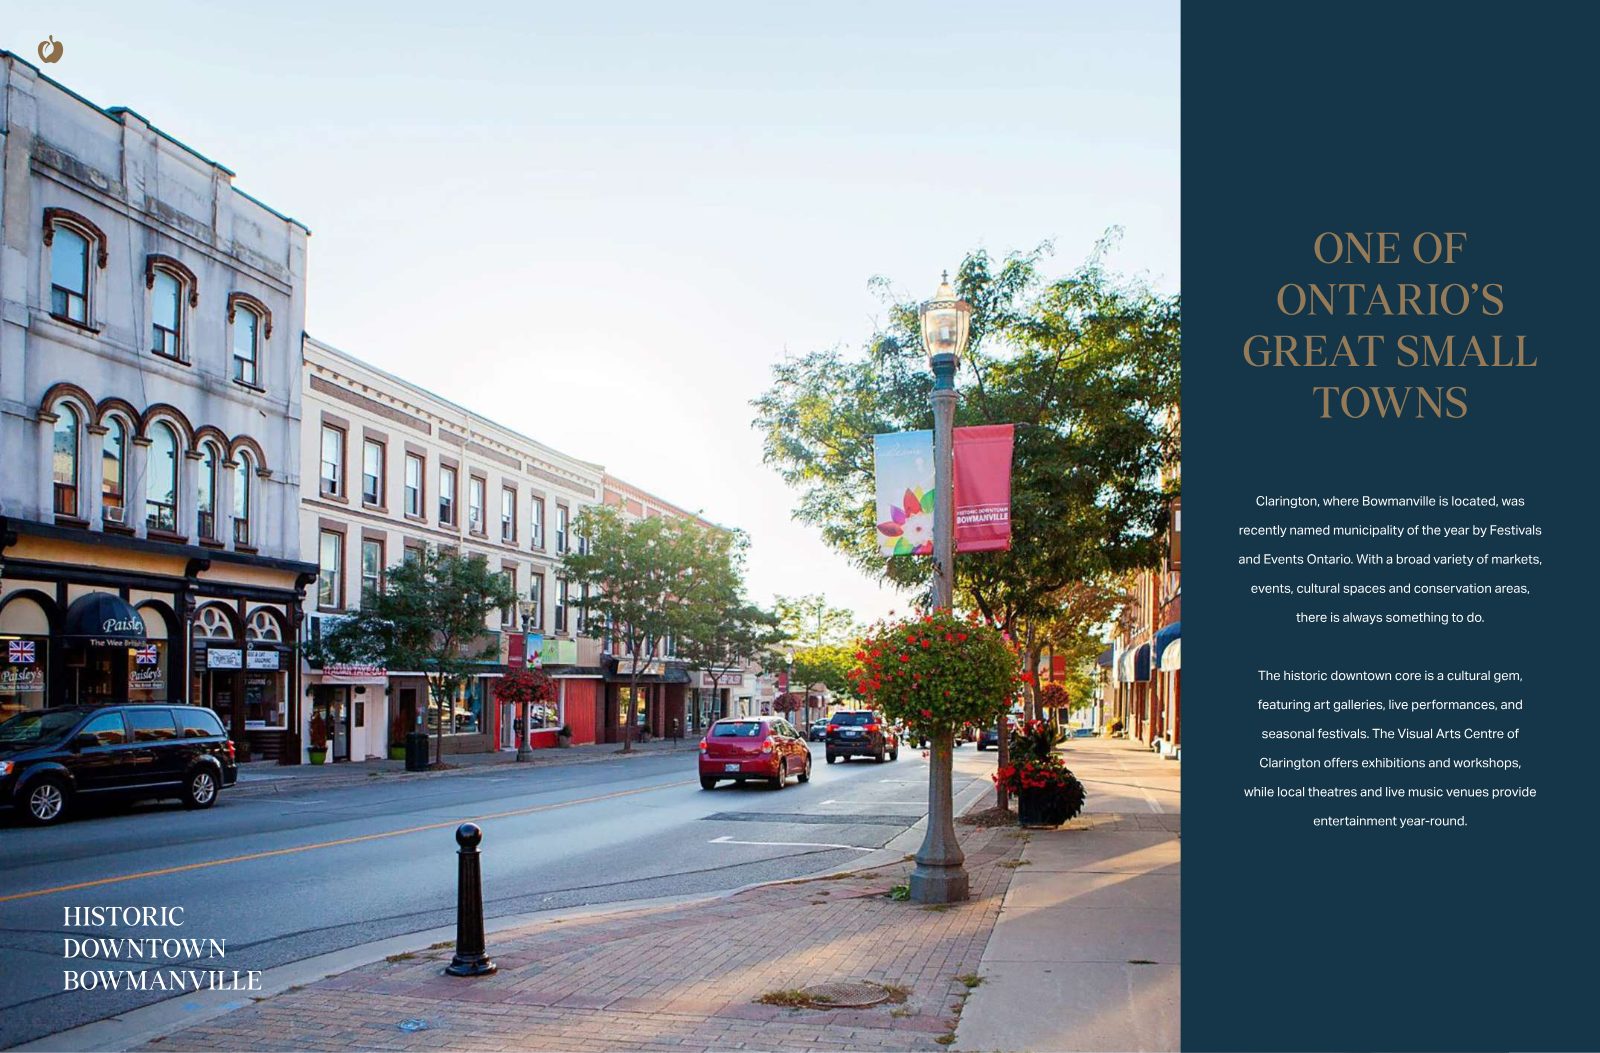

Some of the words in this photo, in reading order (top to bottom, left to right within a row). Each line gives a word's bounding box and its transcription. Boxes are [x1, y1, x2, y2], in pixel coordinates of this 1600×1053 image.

[956, 512, 1008, 524] BOWMANVILLE
[1, 667, 42, 684] Paisley's
[130, 667, 162, 682] Paisley's
